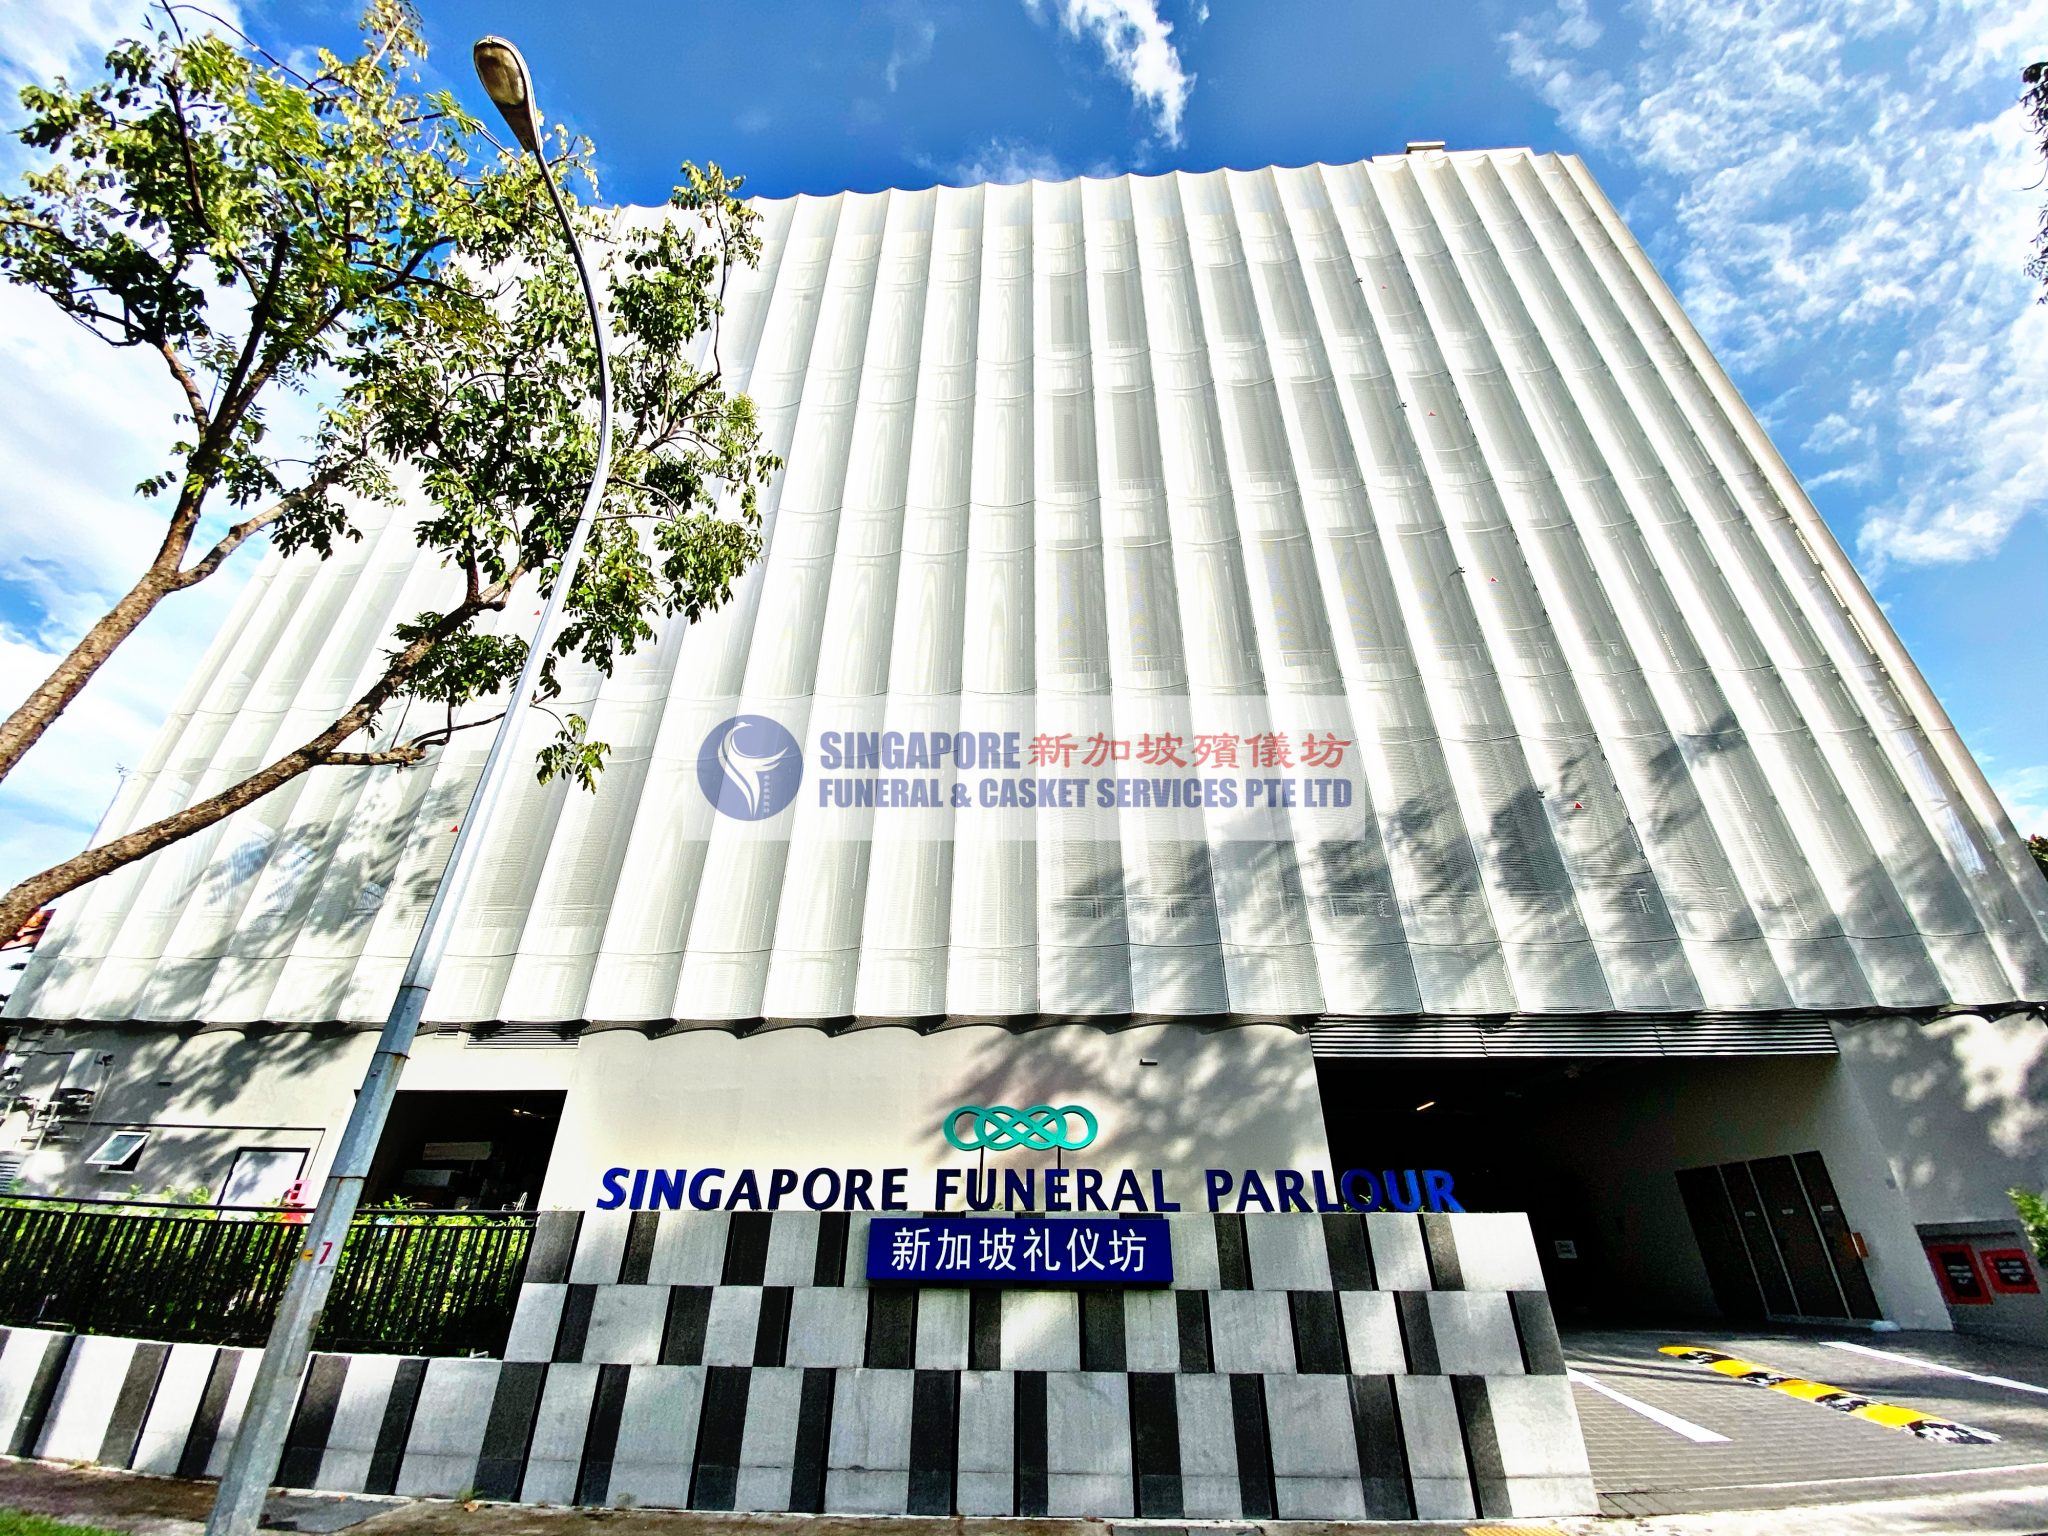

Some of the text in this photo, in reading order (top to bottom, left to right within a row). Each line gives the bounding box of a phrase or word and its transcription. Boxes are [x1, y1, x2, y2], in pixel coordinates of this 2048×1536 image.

[596, 1167, 1466, 1213] SINGAPORE FUNERAL PARLOUR
[319, 1241, 333, 1265] 7
[891, 1227, 1147, 1273] 新加坡礼仪坊
